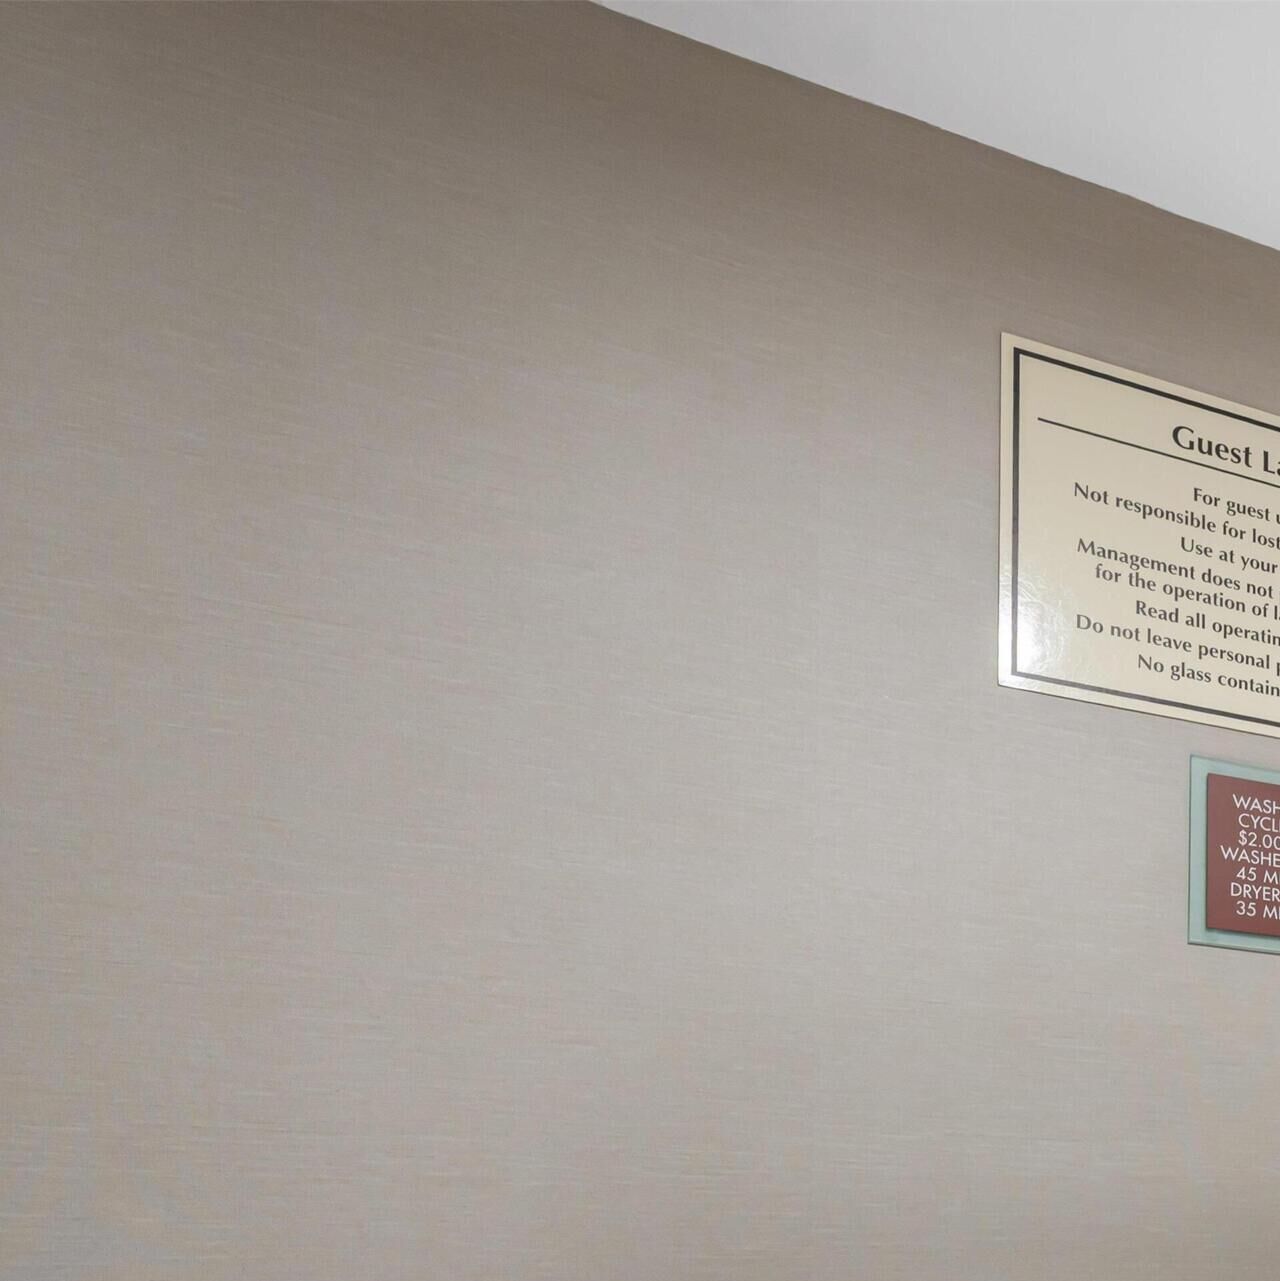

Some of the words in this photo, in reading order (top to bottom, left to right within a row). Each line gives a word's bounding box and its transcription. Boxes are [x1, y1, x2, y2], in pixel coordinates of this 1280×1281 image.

[1172, 426, 1252, 468] Guest
[1075, 482, 1108, 505] Not
[1116, 497, 1216, 532] responsible
[1223, 521, 1246, 539] for
[1253, 528, 1280, 550] lost
[1194, 488, 1220, 507] For
[1227, 501, 1270, 521] guest
[1078, 538, 1195, 580] Management
[1202, 568, 1240, 590] does
[1247, 584, 1272, 599] not
[1181, 537, 1213, 557] Use
[1219, 550, 1234, 563] at
[1241, 556, 1278, 573] your
[1096, 563, 1121, 582] for
[1129, 572, 1156, 591] the
[1163, 584, 1245, 612] operation
[1252, 603, 1269, 617] of
[1136, 600, 1179, 623] Read
[1185, 613, 1205, 629] all
[1077, 614, 1103, 633] Do
[1111, 626, 1140, 641] not
[1148, 628, 1192, 652] leave
[1199, 645, 1269, 669] personal
[1138, 654, 1164, 672] No
[1171, 662, 1211, 682] glass
[1236, 867, 1257, 881] 45
[1231, 883, 1280, 902] DRYER
[1236, 901, 1256, 916] 35
